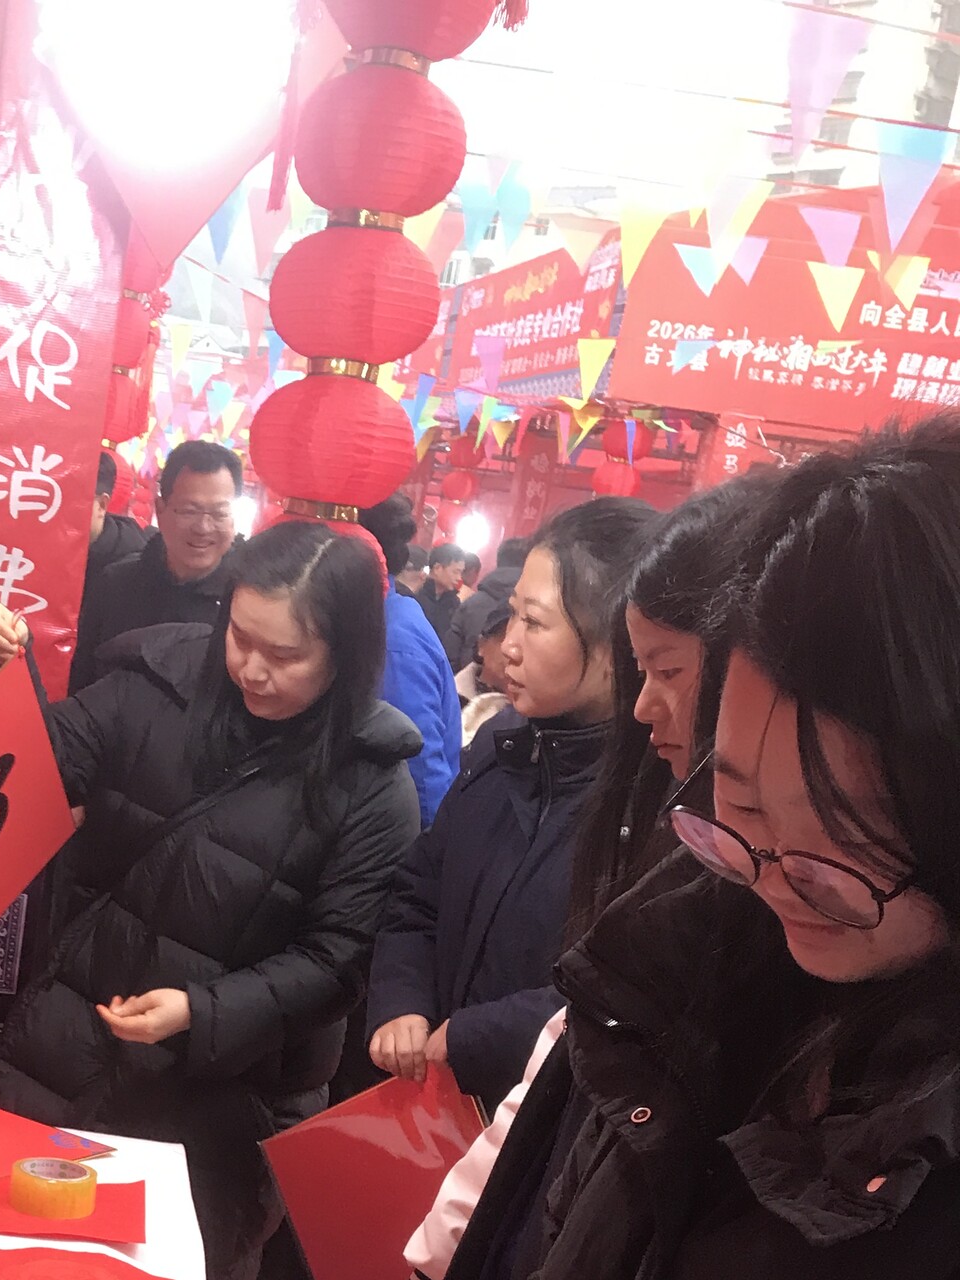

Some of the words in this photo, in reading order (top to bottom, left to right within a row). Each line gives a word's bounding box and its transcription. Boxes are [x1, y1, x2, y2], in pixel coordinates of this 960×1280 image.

[647, 319, 715, 340] 2026年
[859, 300, 960, 336] 向全县人
